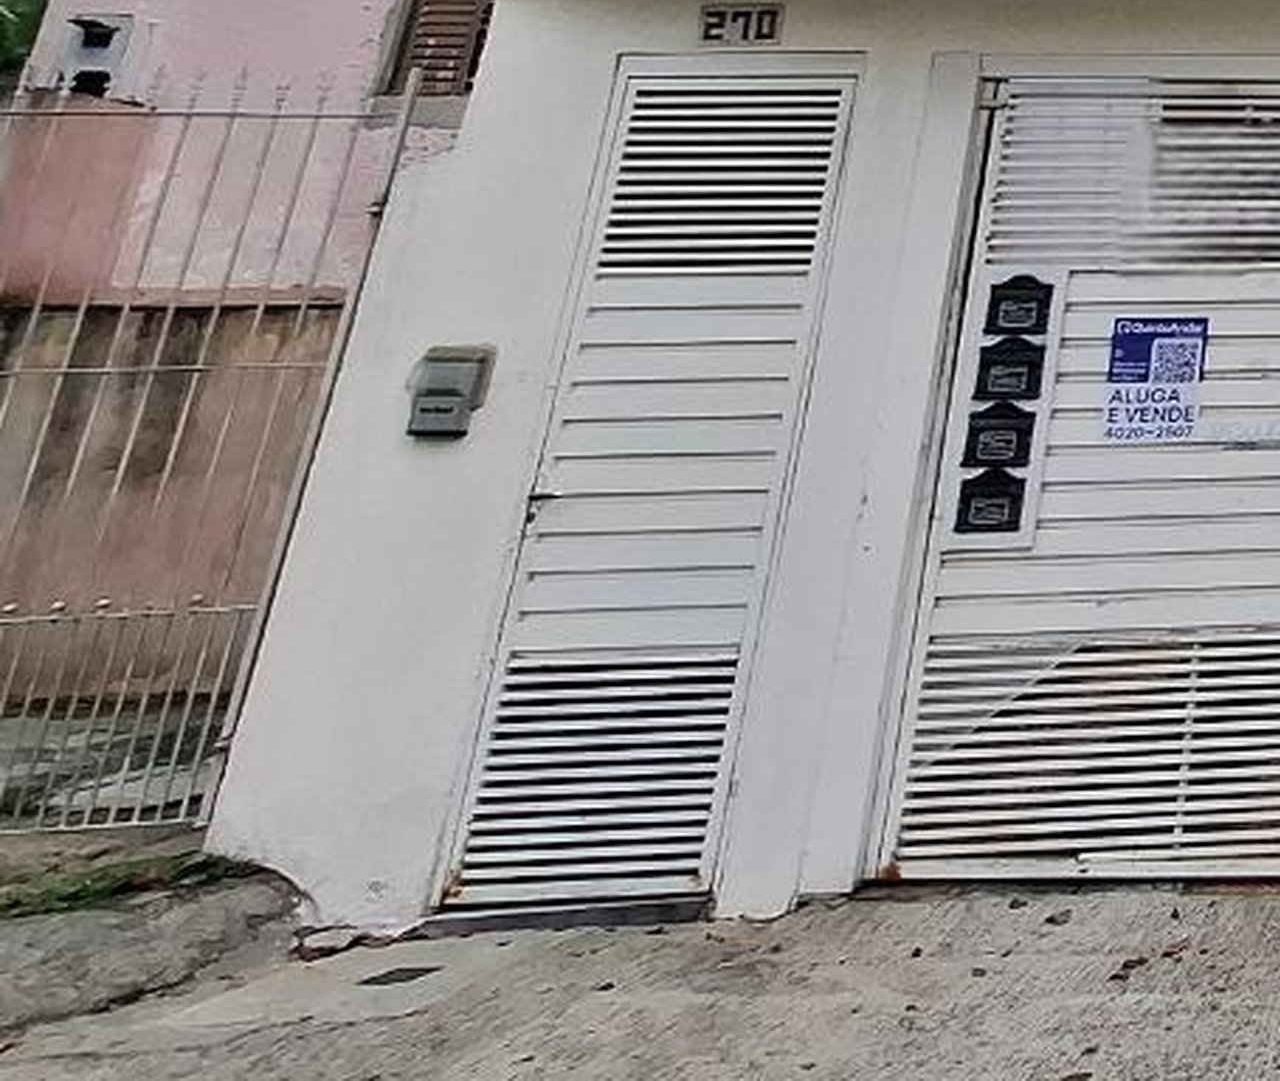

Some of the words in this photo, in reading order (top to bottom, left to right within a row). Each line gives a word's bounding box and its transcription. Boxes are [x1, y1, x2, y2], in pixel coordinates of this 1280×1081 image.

[703, 10, 778, 40] 270
[1108, 387, 1181, 404] ALUGA
[1107, 408, 1119, 423] E
[1125, 406, 1195, 423] VENDE
